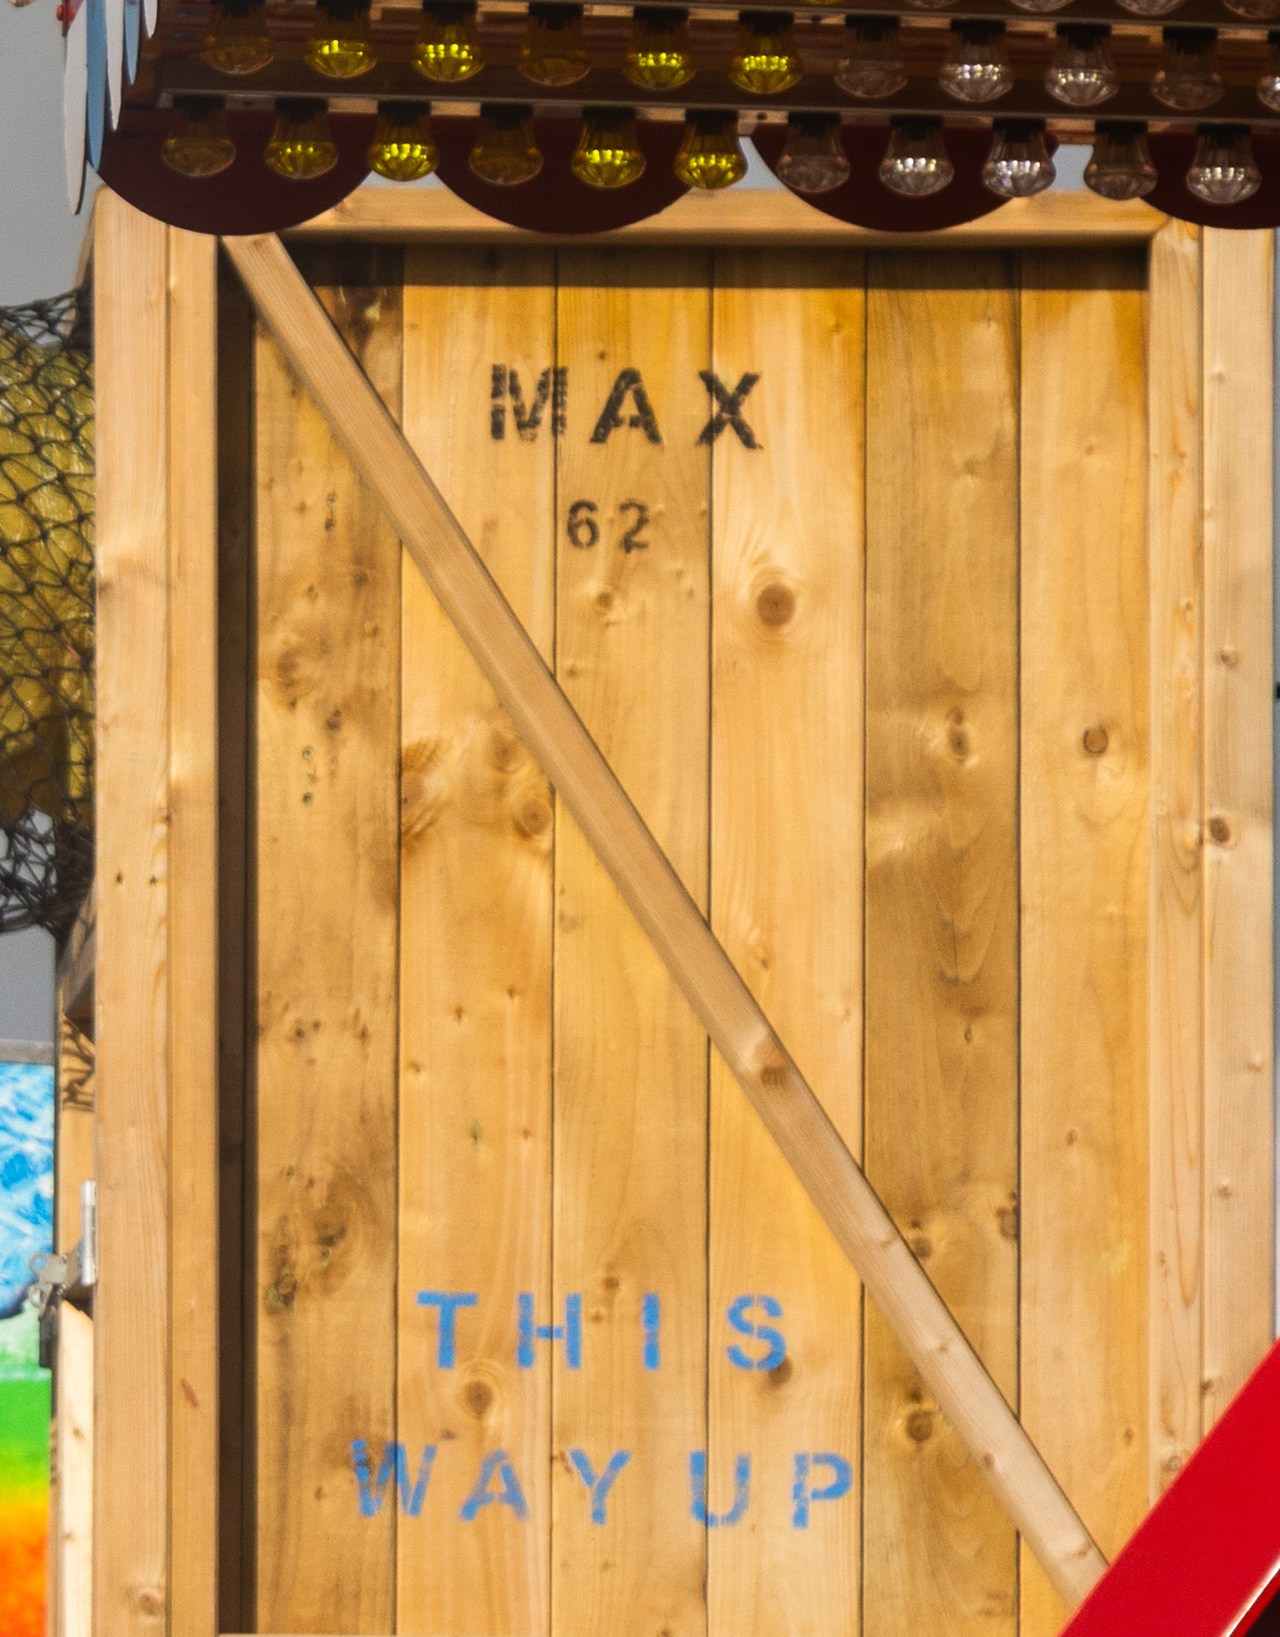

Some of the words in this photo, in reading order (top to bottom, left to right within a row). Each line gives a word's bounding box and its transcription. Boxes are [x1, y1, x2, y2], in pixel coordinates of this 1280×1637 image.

[489, 362, 764, 450] MAX
[566, 500, 652, 553] 62
[416, 1292, 788, 1371] THIS
[351, 1438, 632, 1526] WAY
[689, 1450, 854, 1530] UP
